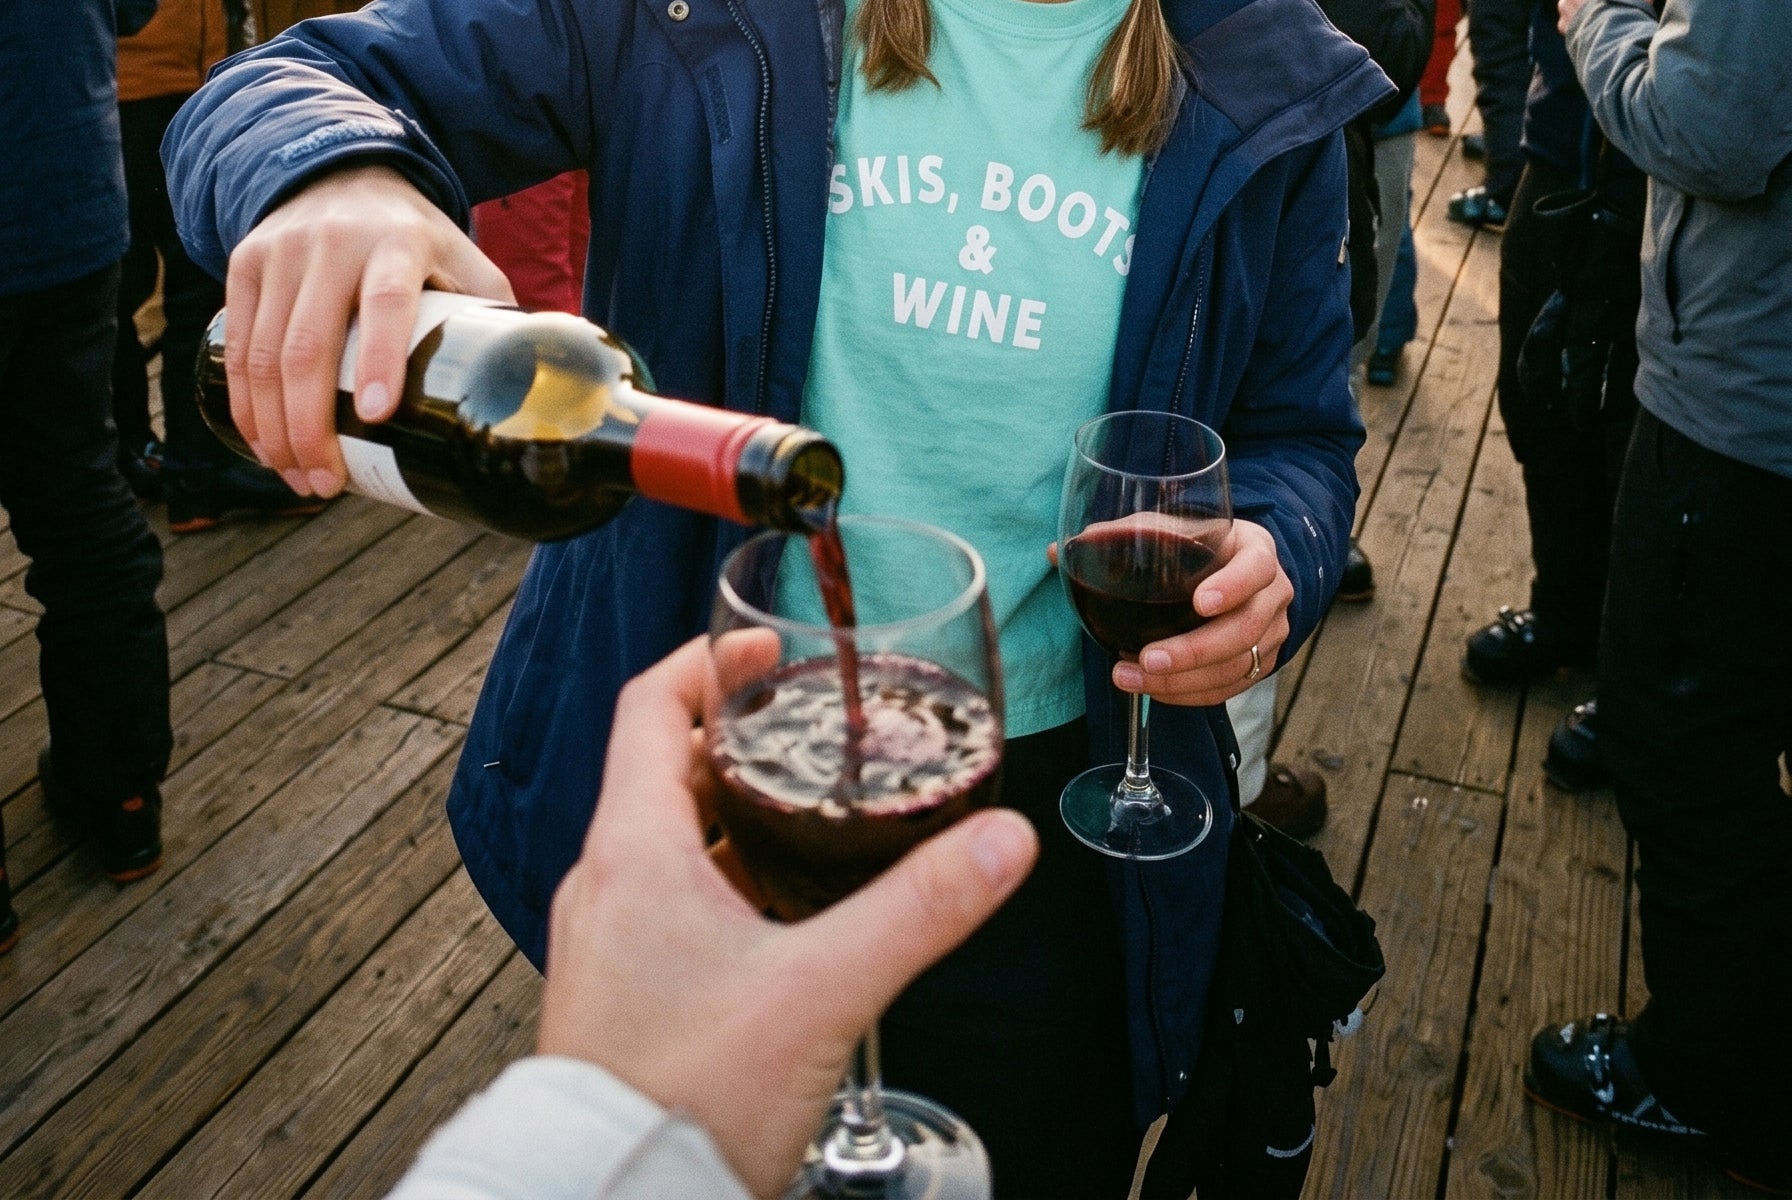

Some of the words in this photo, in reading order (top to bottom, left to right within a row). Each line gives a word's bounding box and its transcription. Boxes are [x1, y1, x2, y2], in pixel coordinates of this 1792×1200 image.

[829, 155, 958, 214] SKIS,
[959, 225, 997, 275] &
[893, 272, 1047, 350] WINE
